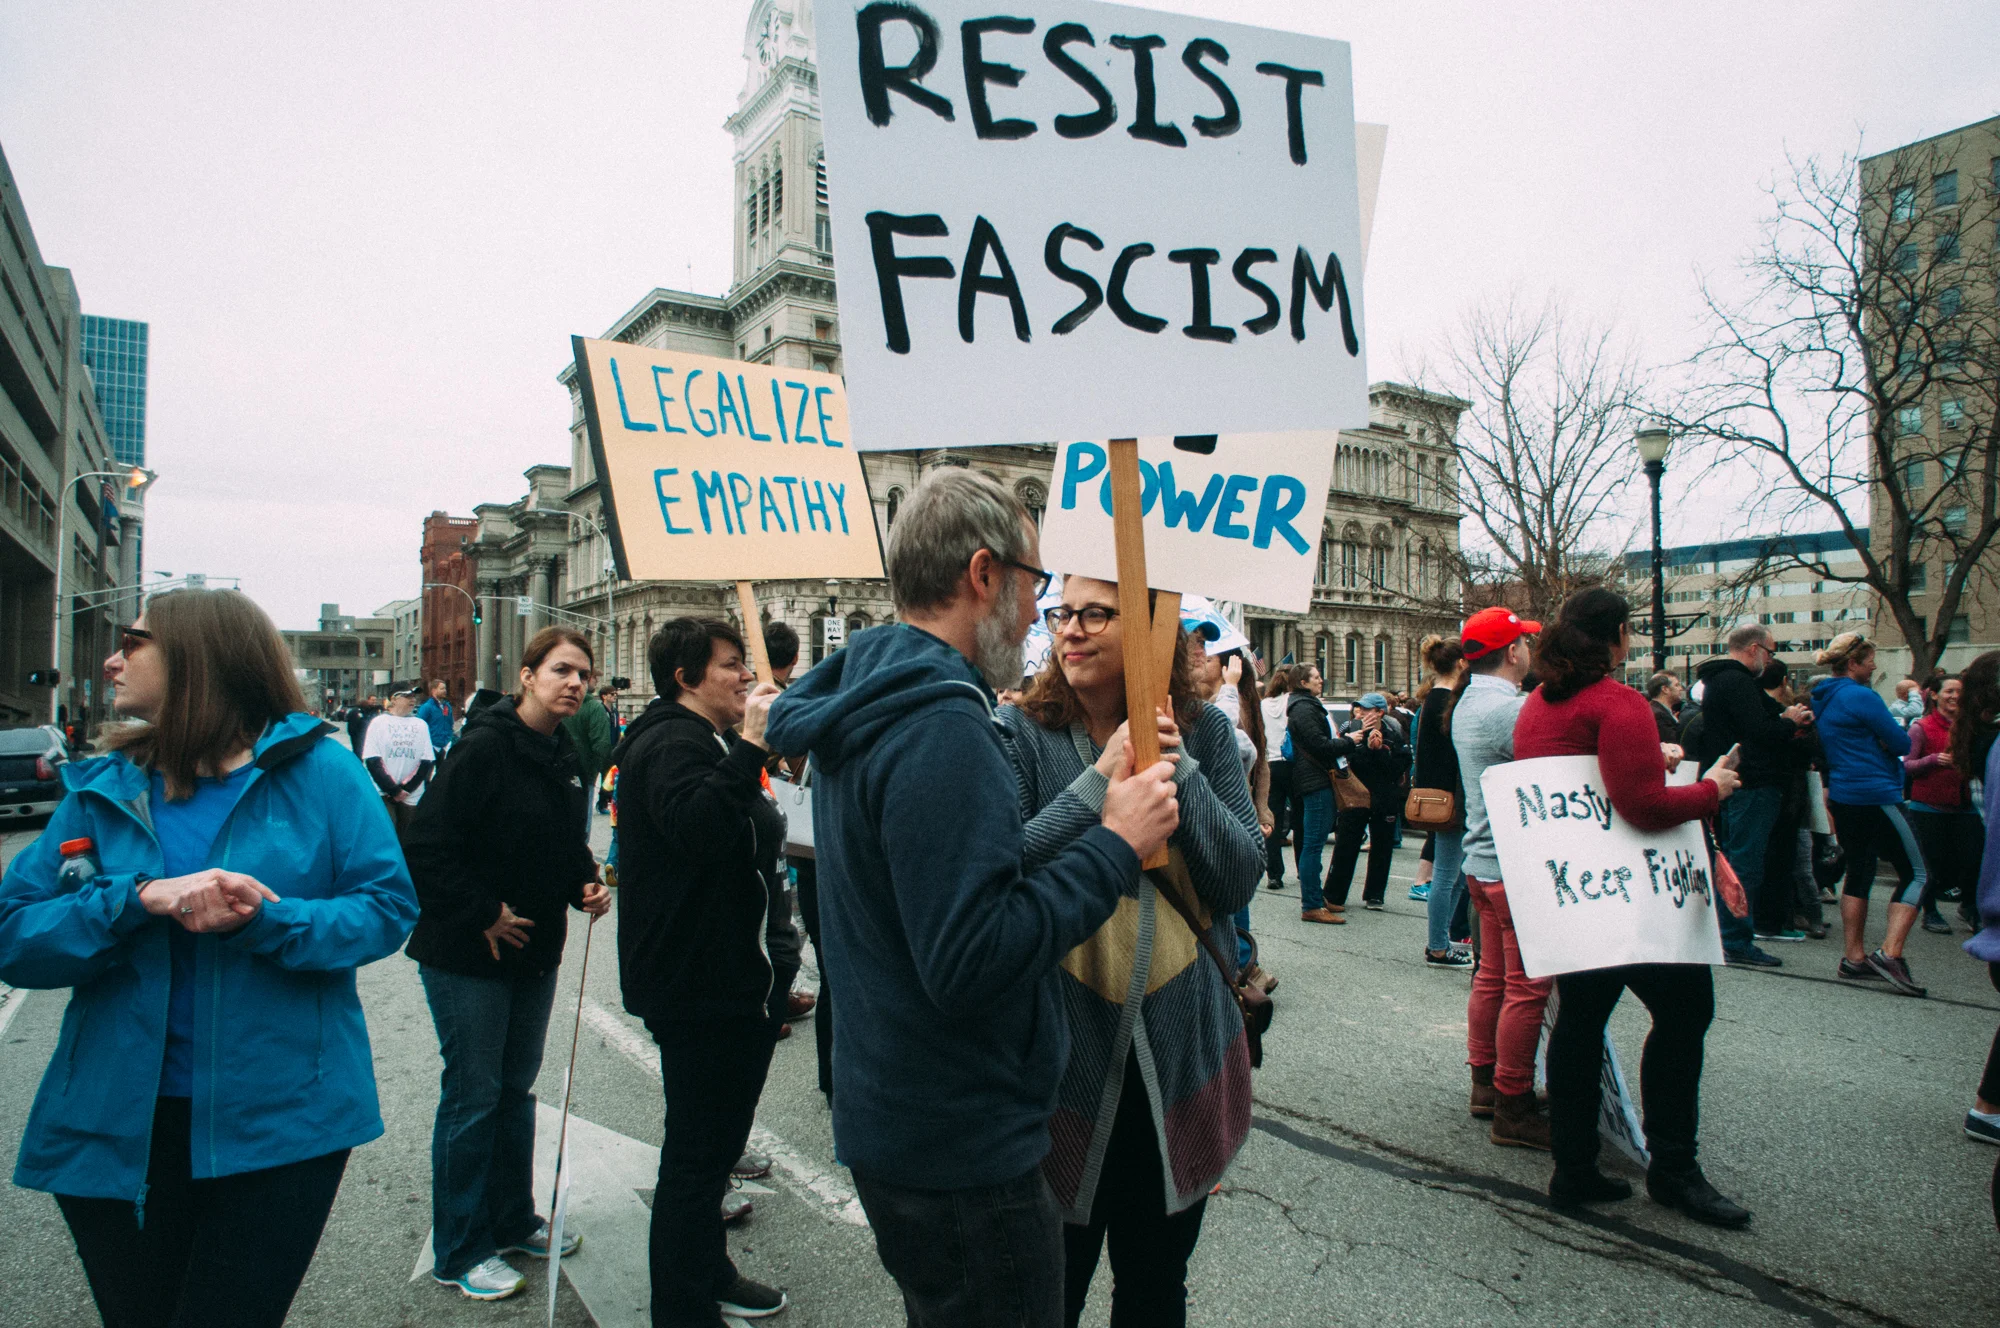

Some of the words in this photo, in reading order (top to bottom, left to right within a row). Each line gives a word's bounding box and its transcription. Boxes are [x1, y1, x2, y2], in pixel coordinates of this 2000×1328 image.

[856, 0, 1325, 166] RESIST
[865, 210, 1359, 357] FASCISM
[610, 357, 844, 448] LEGALIZE
[653, 467, 850, 535] EMPATHY
[388, 723, 419, 734] MAKE
[388, 747, 417, 760] AGAIN
[1515, 783, 1612, 831] Nasty
[1642, 848, 1712, 909] Fighting
